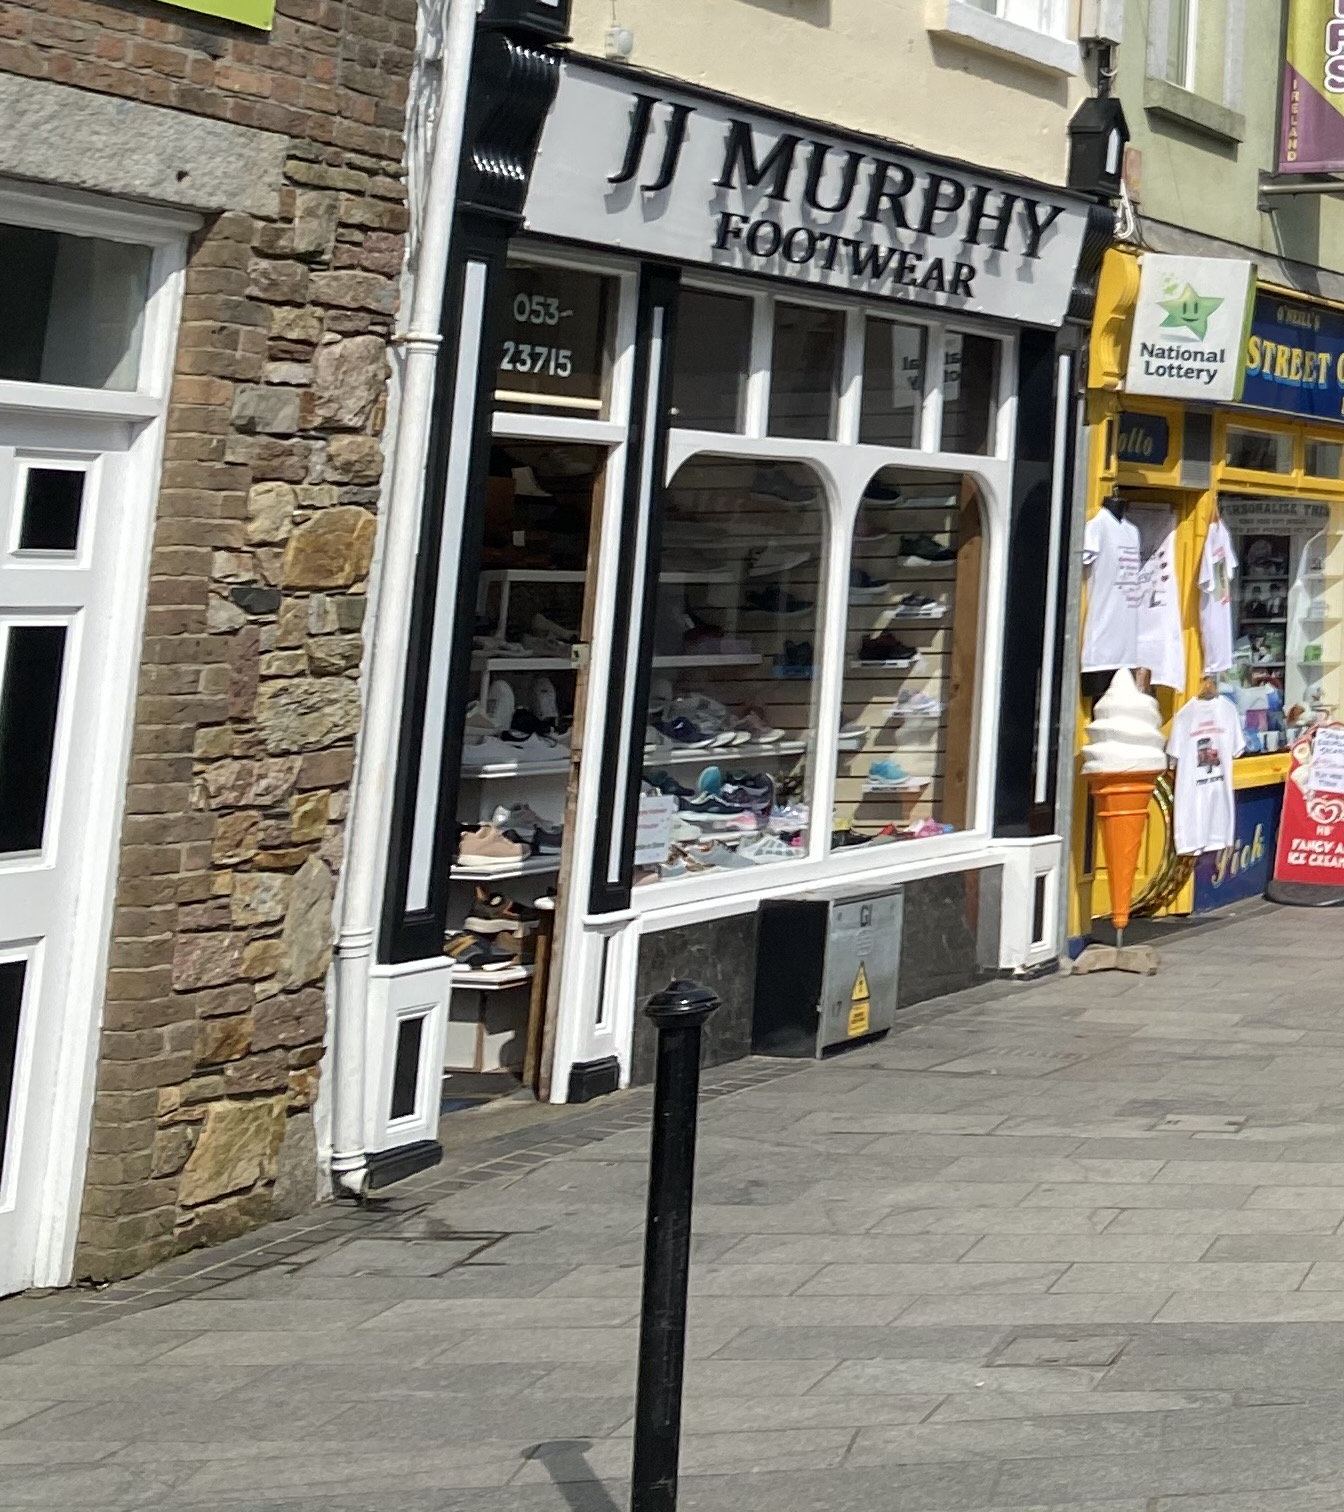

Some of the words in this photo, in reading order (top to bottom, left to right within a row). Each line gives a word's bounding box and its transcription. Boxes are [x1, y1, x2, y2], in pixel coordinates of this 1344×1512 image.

[1286, 79, 1301, 162] IRELAND
[608, 92, 698, 193] JJ
[714, 120, 1067, 260] MURPHY
[713, 210, 977, 299] FOOTWEAR
[500, 338, 572, 379] 23715
[1140, 342, 1225, 364] National
[1144, 360, 1218, 385] Lottery
[1246, 335, 1332, 388] STREET
[1287, 851, 1308, 865] ICE
[1291, 838, 1335, 853] FANCY
